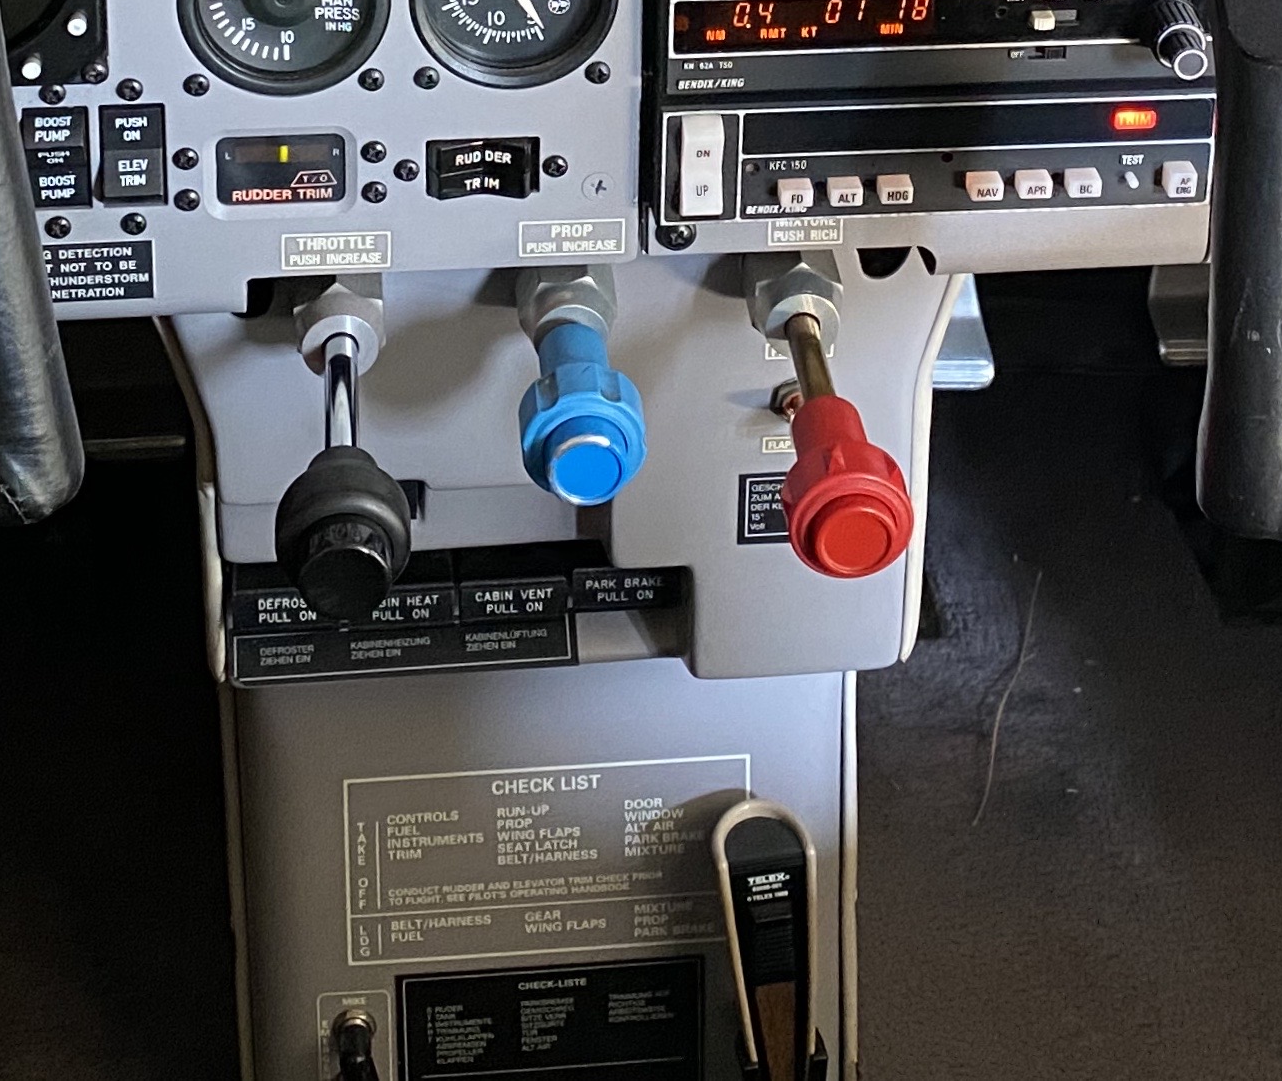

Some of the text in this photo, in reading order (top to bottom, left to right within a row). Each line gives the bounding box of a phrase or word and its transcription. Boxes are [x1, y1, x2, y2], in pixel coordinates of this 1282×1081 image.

[314, 6, 360, 21] PRESS
[696, 149, 711, 158] DN
[1121, 154, 1145, 166] TEST
[117, 158, 149, 172] ELEV
[38, 174, 77, 188] BOOST
[119, 173, 147, 187] TRIM
[40, 187, 76, 200] PUMP
[232, 186, 334, 202] RUDDER TRIM
[695, 184, 709, 197] UP
[887, 190, 909, 202] HDG
[976, 188, 997, 198] NAV
[1027, 185, 1047, 195] APR
[1079, 184, 1092, 195] BC
[837, 193, 857, 204] ALT
[551, 223, 594, 238] PROP
[297, 236, 374, 250] THROTTLE
[525, 239, 617, 254] PUSH INCREASE
[58, 246, 132, 260] DETECTION
[289, 252, 382, 266] PUSH INCREASE
[475, 587, 554, 602] CABIN VENT
[486, 601, 543, 614] PULL ON
[492, 774, 601, 794] CHECK LIST
[624, 797, 663, 810] DOOR
[386, 810, 459, 825] CONTROLS
[388, 848, 422, 861] TRIM
